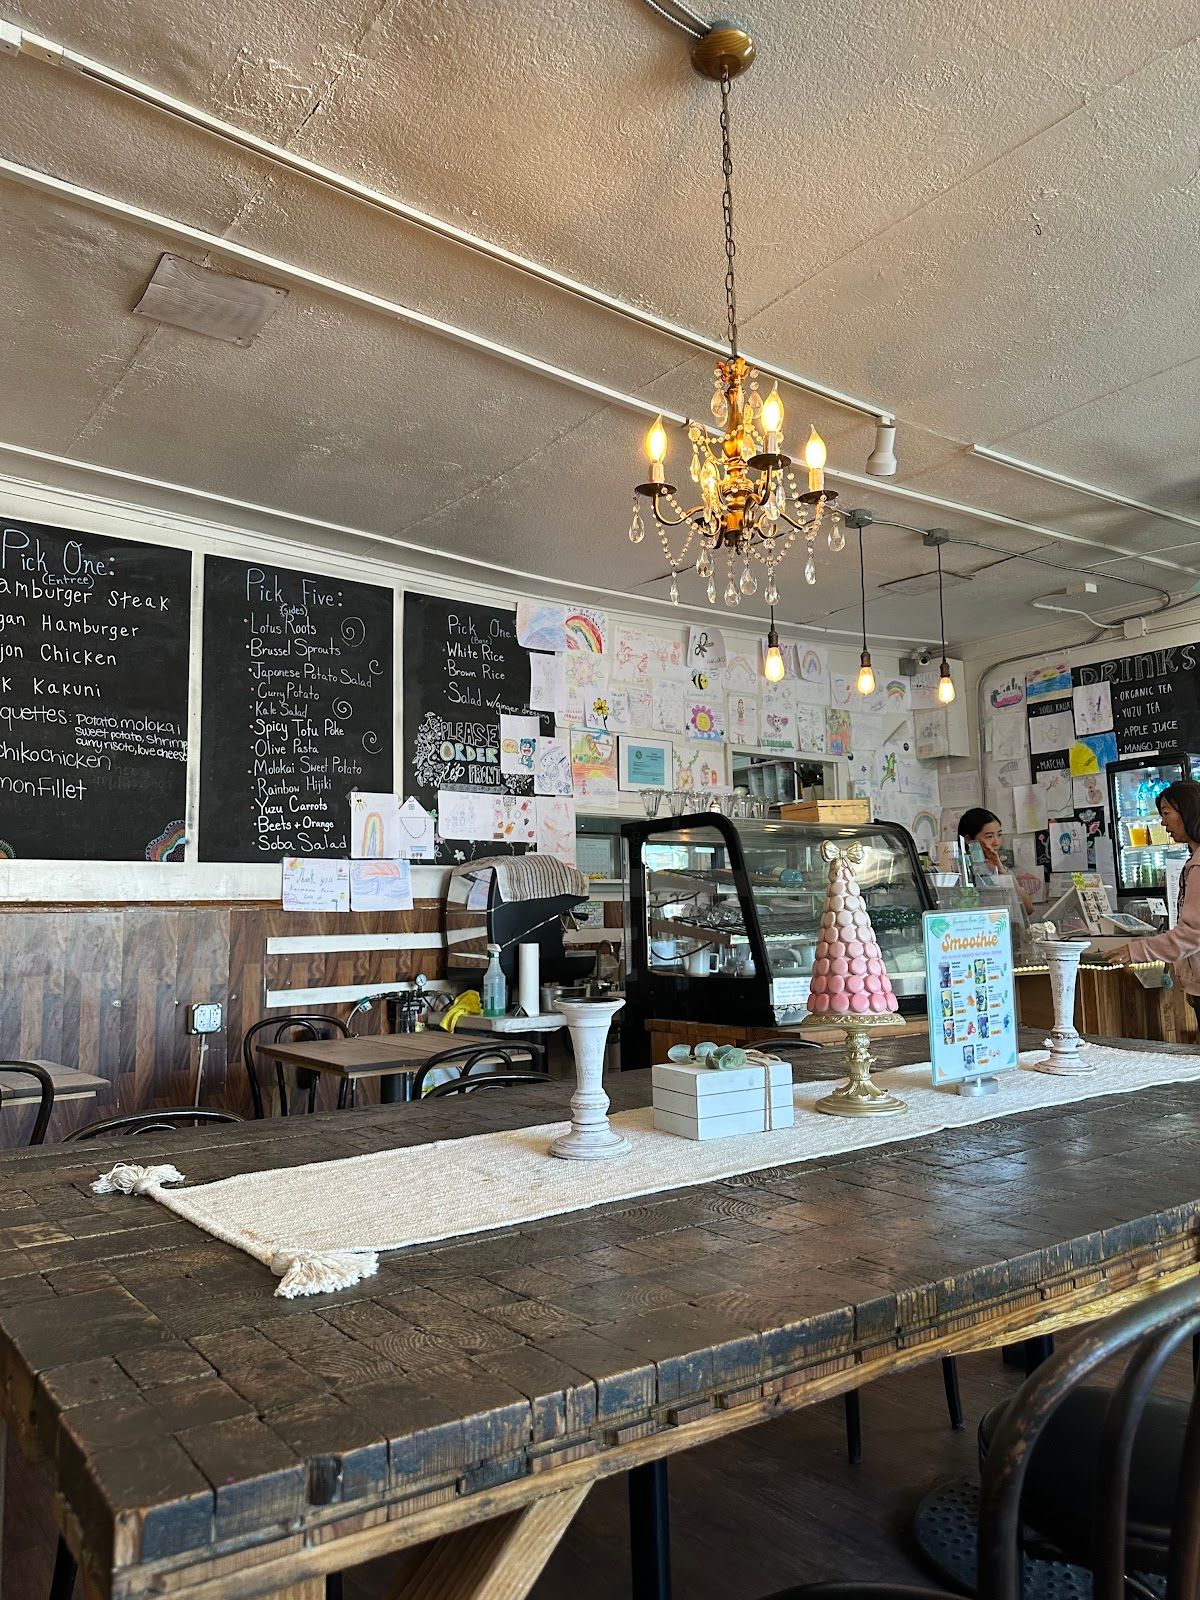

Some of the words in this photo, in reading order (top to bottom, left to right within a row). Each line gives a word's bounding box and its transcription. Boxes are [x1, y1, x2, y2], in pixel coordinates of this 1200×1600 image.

[3, 529, 48, 573] Pick
[63, 541, 116, 575] One:
[246, 568, 284, 602] Pick
[302, 579, 343, 606] Five:
[42, 614, 139, 641] Hamburger
[251, 612, 282, 634] Lotus
[285, 613, 317, 635] Roots
[448, 614, 477, 636] Pick
[40, 644, 117, 666] Chicken
[250, 638, 291, 657] Brussel
[294, 636, 341, 661] Sprouts
[446, 641, 479, 659] White
[481, 644, 505, 662] Rice
[251, 661, 301, 684] Japanese
[304, 662, 338, 682] Potato
[340, 668, 372, 688] Salad
[447, 659, 477, 677] Brown
[482, 663, 506, 680] Rice
[33, 677, 101, 697] Kakuni
[257, 682, 286, 704] Curry
[286, 681, 320, 700] Potato
[448, 681, 481, 706] Salad
[1119, 685, 1154, 701] ORGANIC
[1158, 683, 1173, 694] TEA
[255, 701, 277, 716] Kale
[280, 703, 308, 718] Salad
[1122, 707, 1142, 719] YUZU
[1146, 702, 1161, 715] TEA
[254, 718, 288, 741] Spicy
[291, 719, 319, 737] Tofu
[324, 718, 345, 736] Poke
[440, 721, 500, 749] PLEASE
[1123, 724, 1149, 738] APPLE
[1151, 720, 1178, 734] JUICE
[255, 739, 287, 757] Olive
[293, 738, 319, 754] Pasta
[439, 741, 499, 764] ORDER
[1124, 743, 1153, 754] MANGO
[1155, 740, 1178, 752] JUICE
[254, 759, 295, 776] Molokai
[300, 756, 329, 774] Sweet
[332, 756, 363, 775] Potato
[468, 763, 501, 785] FRONT
[1039, 757, 1066, 771] MATCHA
[257, 777, 300, 798] Rainbow
[306, 776, 332, 795] Hijiki
[254, 796, 284, 816] Yuzu
[289, 795, 328, 812] Carrots
[257, 815, 292, 833] Beets
[302, 816, 335, 832] Orange
[258, 835, 297, 851] Soba
[297, 832, 347, 852] Salad
[941, 930, 999, 952] Smoothie
